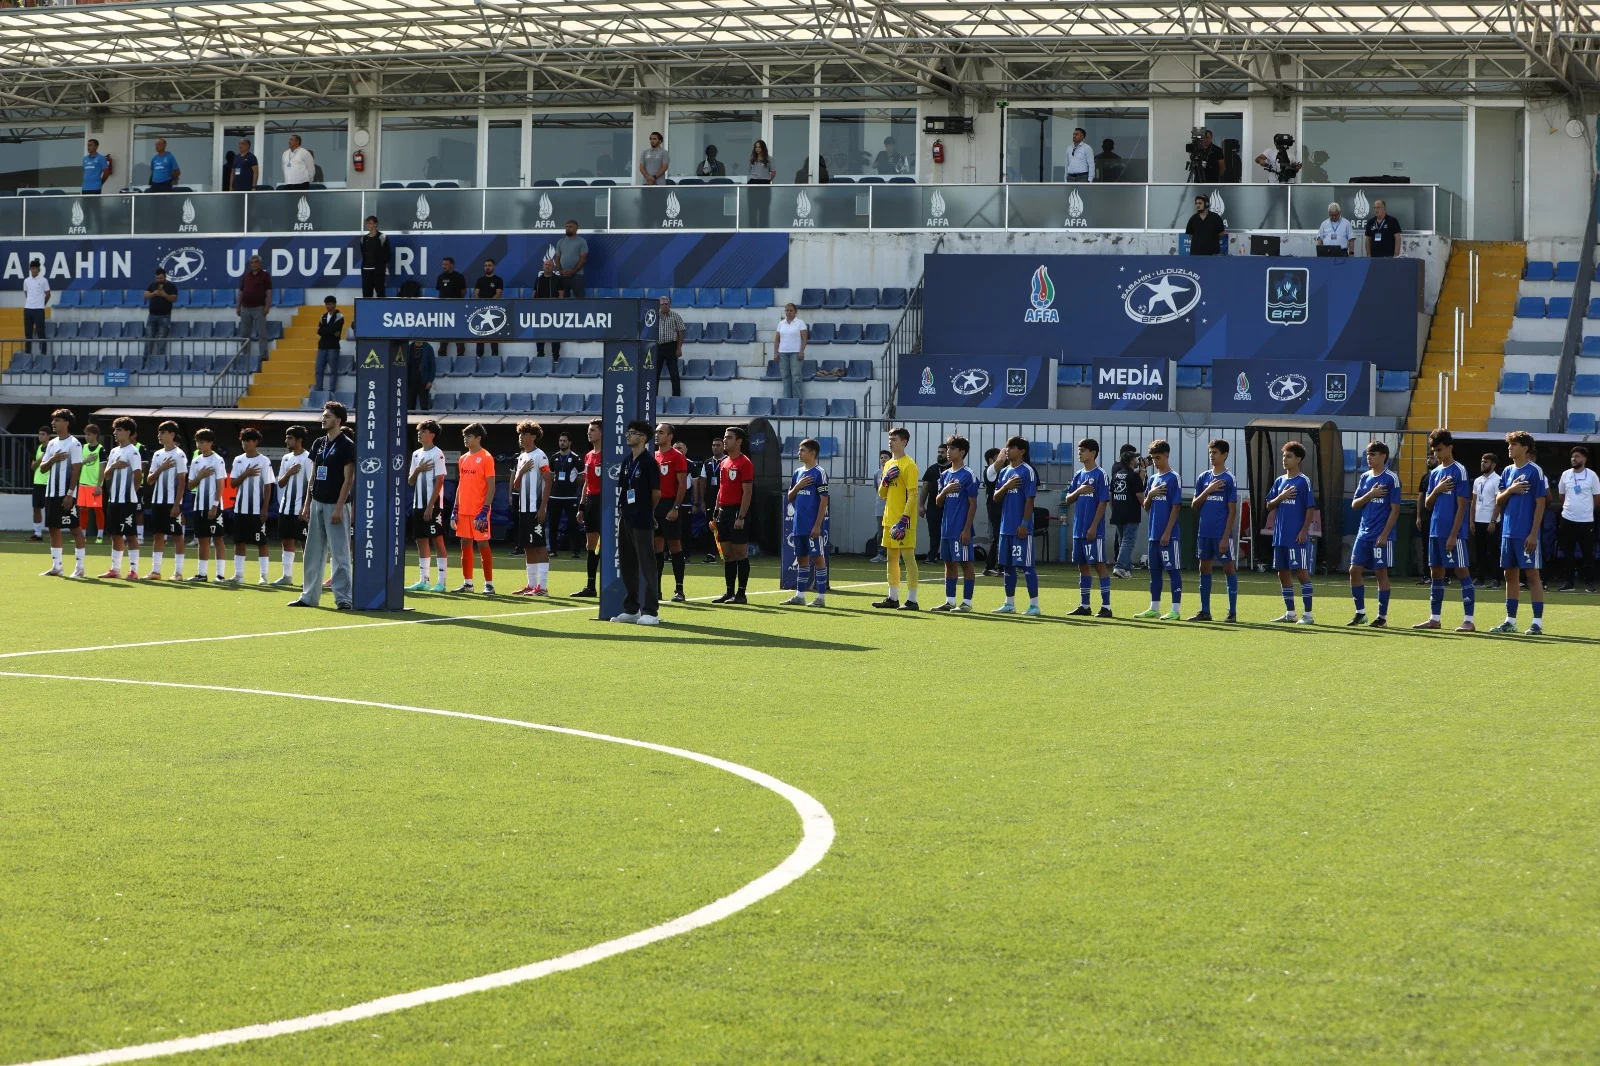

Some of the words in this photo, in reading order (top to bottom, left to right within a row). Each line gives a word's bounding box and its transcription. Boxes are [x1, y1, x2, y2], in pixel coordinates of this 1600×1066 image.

[294, 222, 313, 230] AFFA
[412, 221, 432, 229] AFFA
[535, 220, 556, 228] AFFA
[662, 219, 684, 228] AFFA
[792, 218, 814, 226] AFFA
[926, 218, 949, 226] AFFA
[1064, 218, 1088, 226] AFFA
[1350, 220, 1367, 228] AFF
[68, 226, 86, 234] AFFA
[226, 246, 428, 278] UDUZLRI
[1121, 273, 1152, 300] SABAHIN
[1156, 268, 1200, 280] ULDUZLARI
[1024, 308, 1060, 322] AFFA
[1272, 310, 1302, 318] BFF
[382, 312, 455, 328] SABAHIN
[520, 312, 612, 328] ULDUZLARI
[1098, 364, 1163, 386] MEDİA
[1122, 392, 1163, 400] STADİONU
[368, 381, 376, 450] SABAHIN
[616, 384, 624, 454] SABAHIN
[62, 516, 71, 524] 25
[366, 480, 374, 568] ULDUZLARI
[120, 524, 124, 532] 7
[210, 526, 216, 534] 17
[430, 526, 436, 534] 5
[256, 532, 260, 542] 8
[954, 542, 960, 552] 8
[1012, 546, 1022, 556] 23
[1084, 544, 1092, 556] 17
[1162, 550, 1170, 562] 19
[1290, 548, 1296, 560] 11
[1374, 548, 1382, 558] 18
